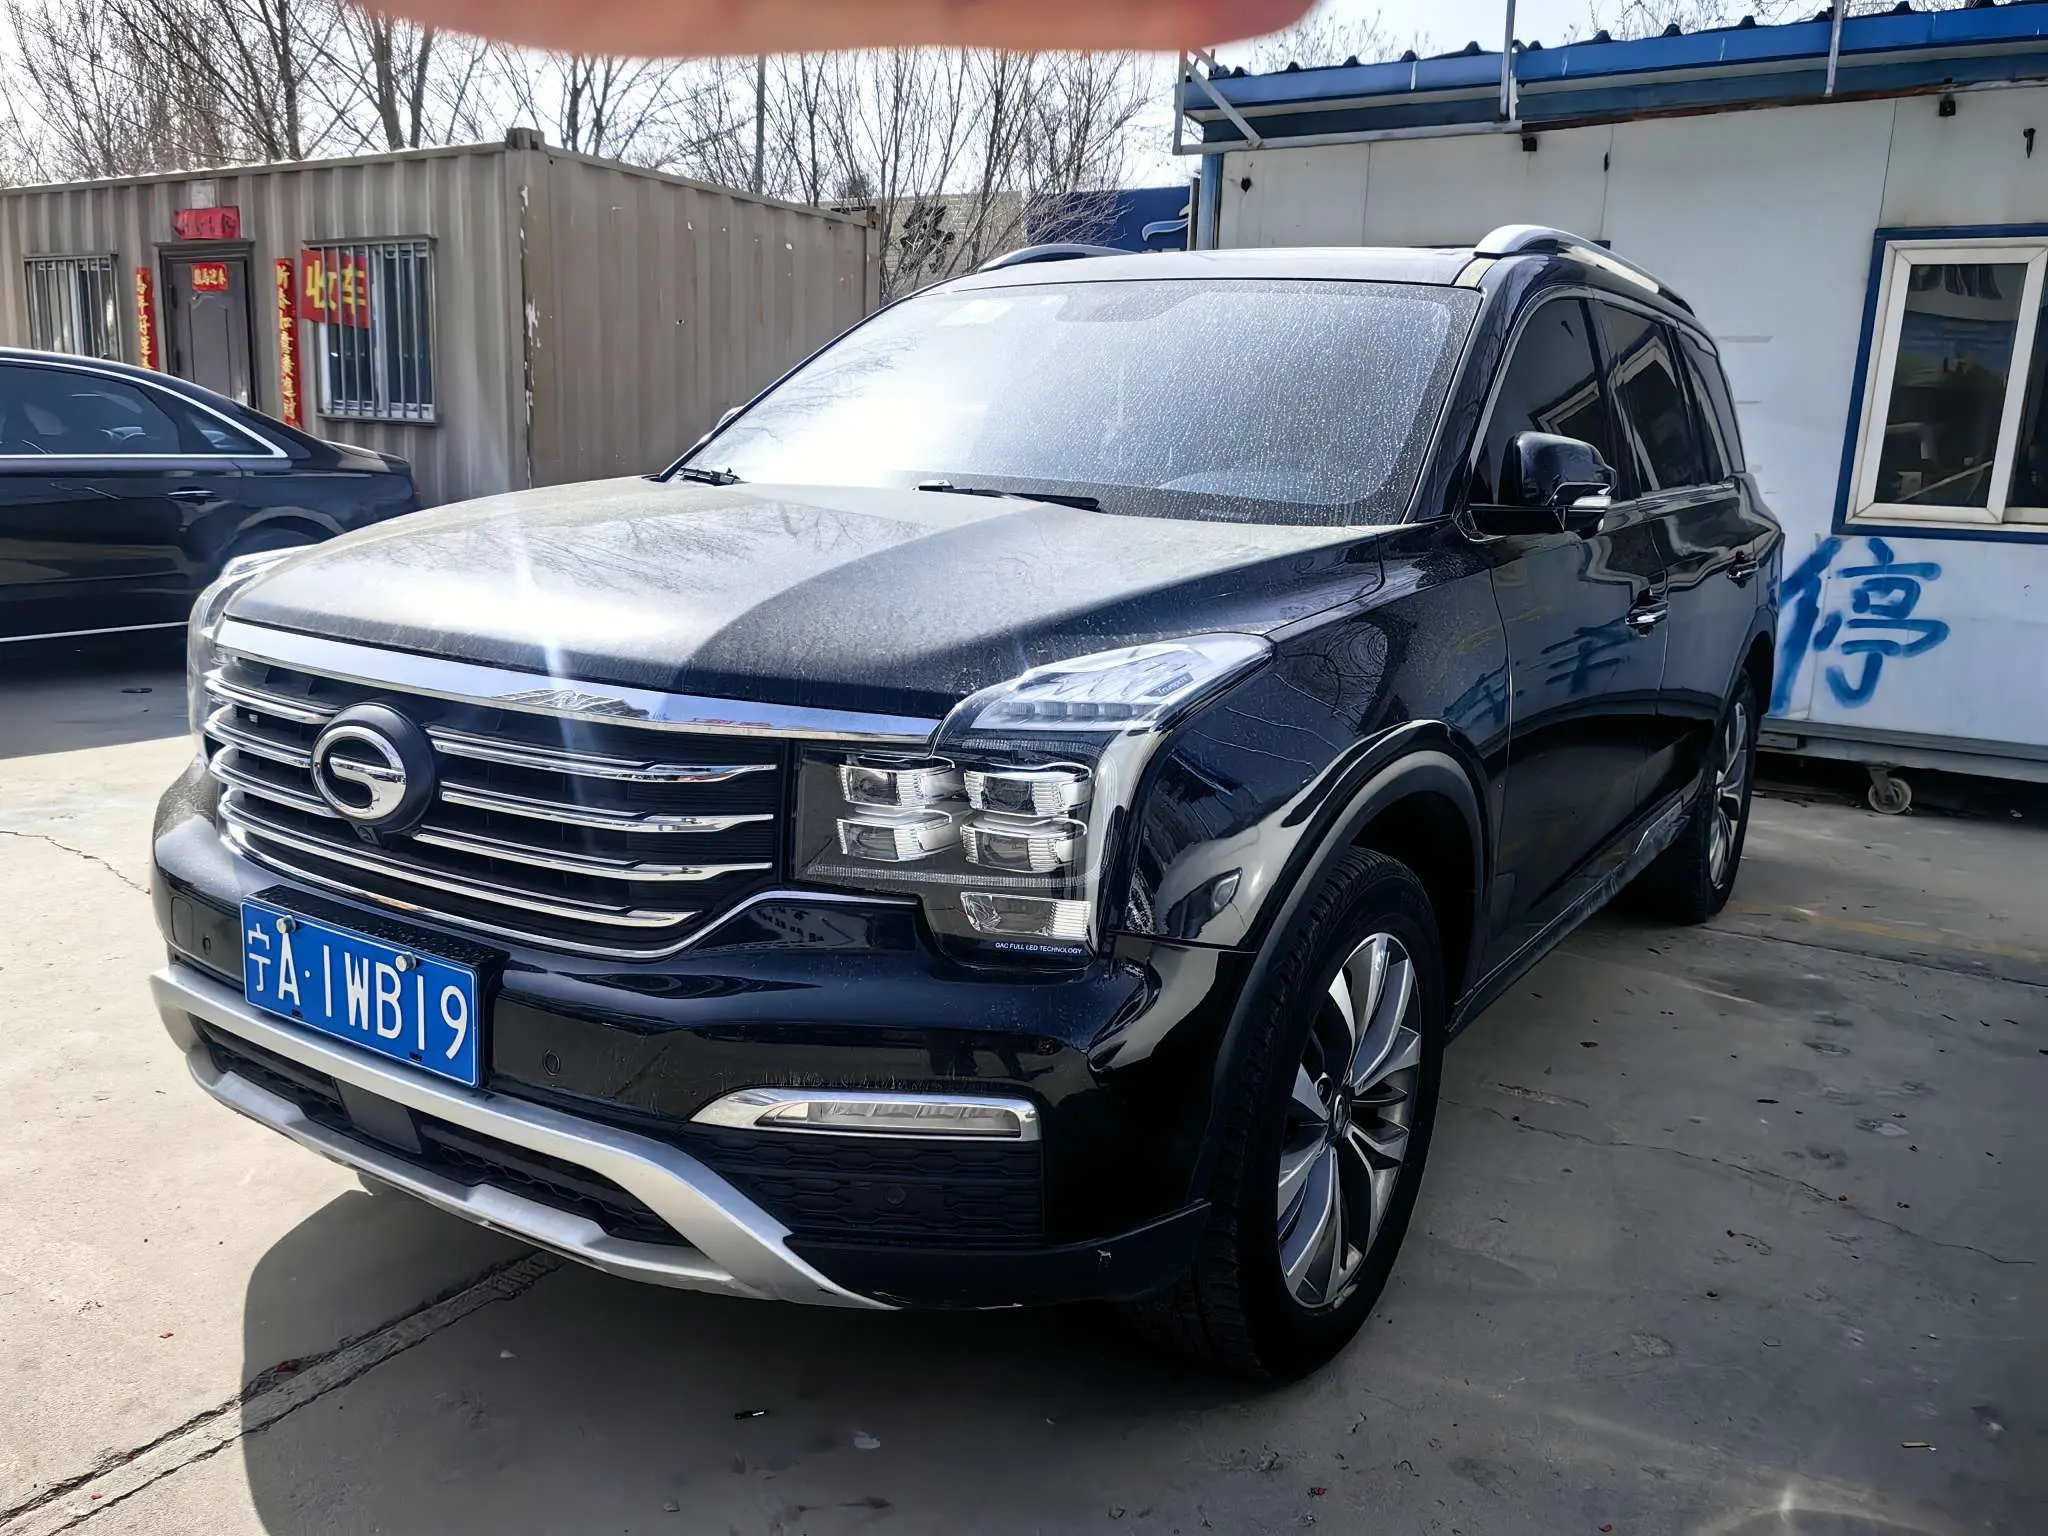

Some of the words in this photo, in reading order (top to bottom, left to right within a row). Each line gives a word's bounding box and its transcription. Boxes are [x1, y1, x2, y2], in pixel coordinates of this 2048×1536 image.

[306, 259, 367, 315] 收车
[1772, 536, 1950, 716] 停
[1040, 945, 1082, 954] TECHNOLOGY
